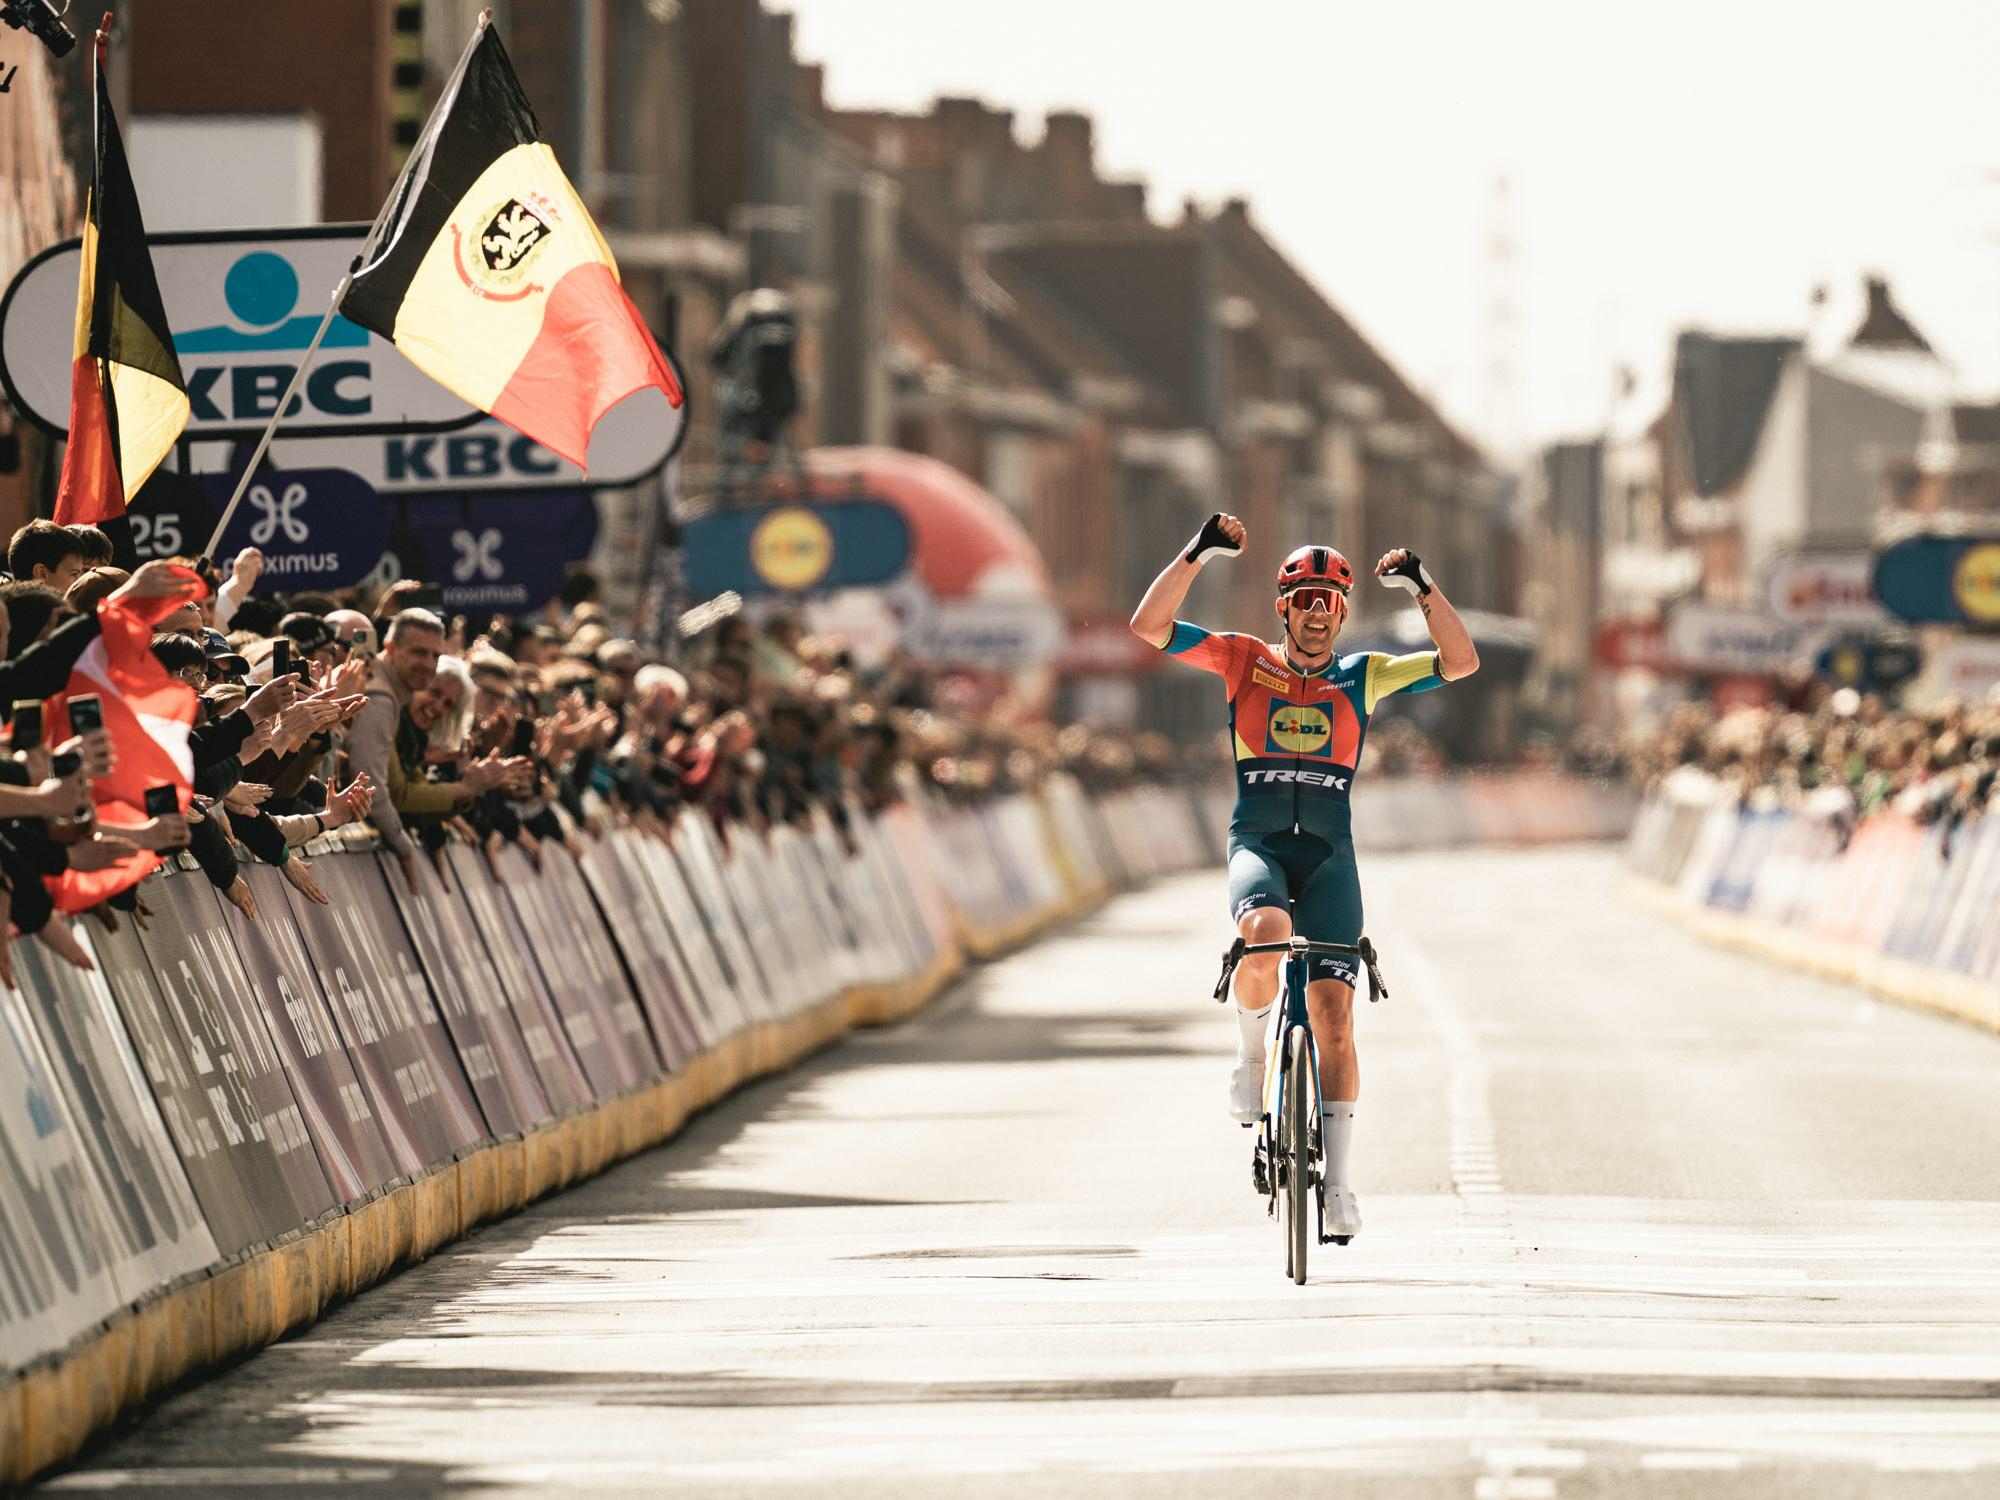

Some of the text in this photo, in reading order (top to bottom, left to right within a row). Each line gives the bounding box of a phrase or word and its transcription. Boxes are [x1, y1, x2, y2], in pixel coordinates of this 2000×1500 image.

[186, 360, 372, 421] KBC
[385, 434, 559, 480] KBC
[222, 551, 340, 579] pximus
[1255, 655, 1290, 679] Santini
[1243, 769, 1348, 791] TREK
[1319, 958, 1352, 969] Santini
